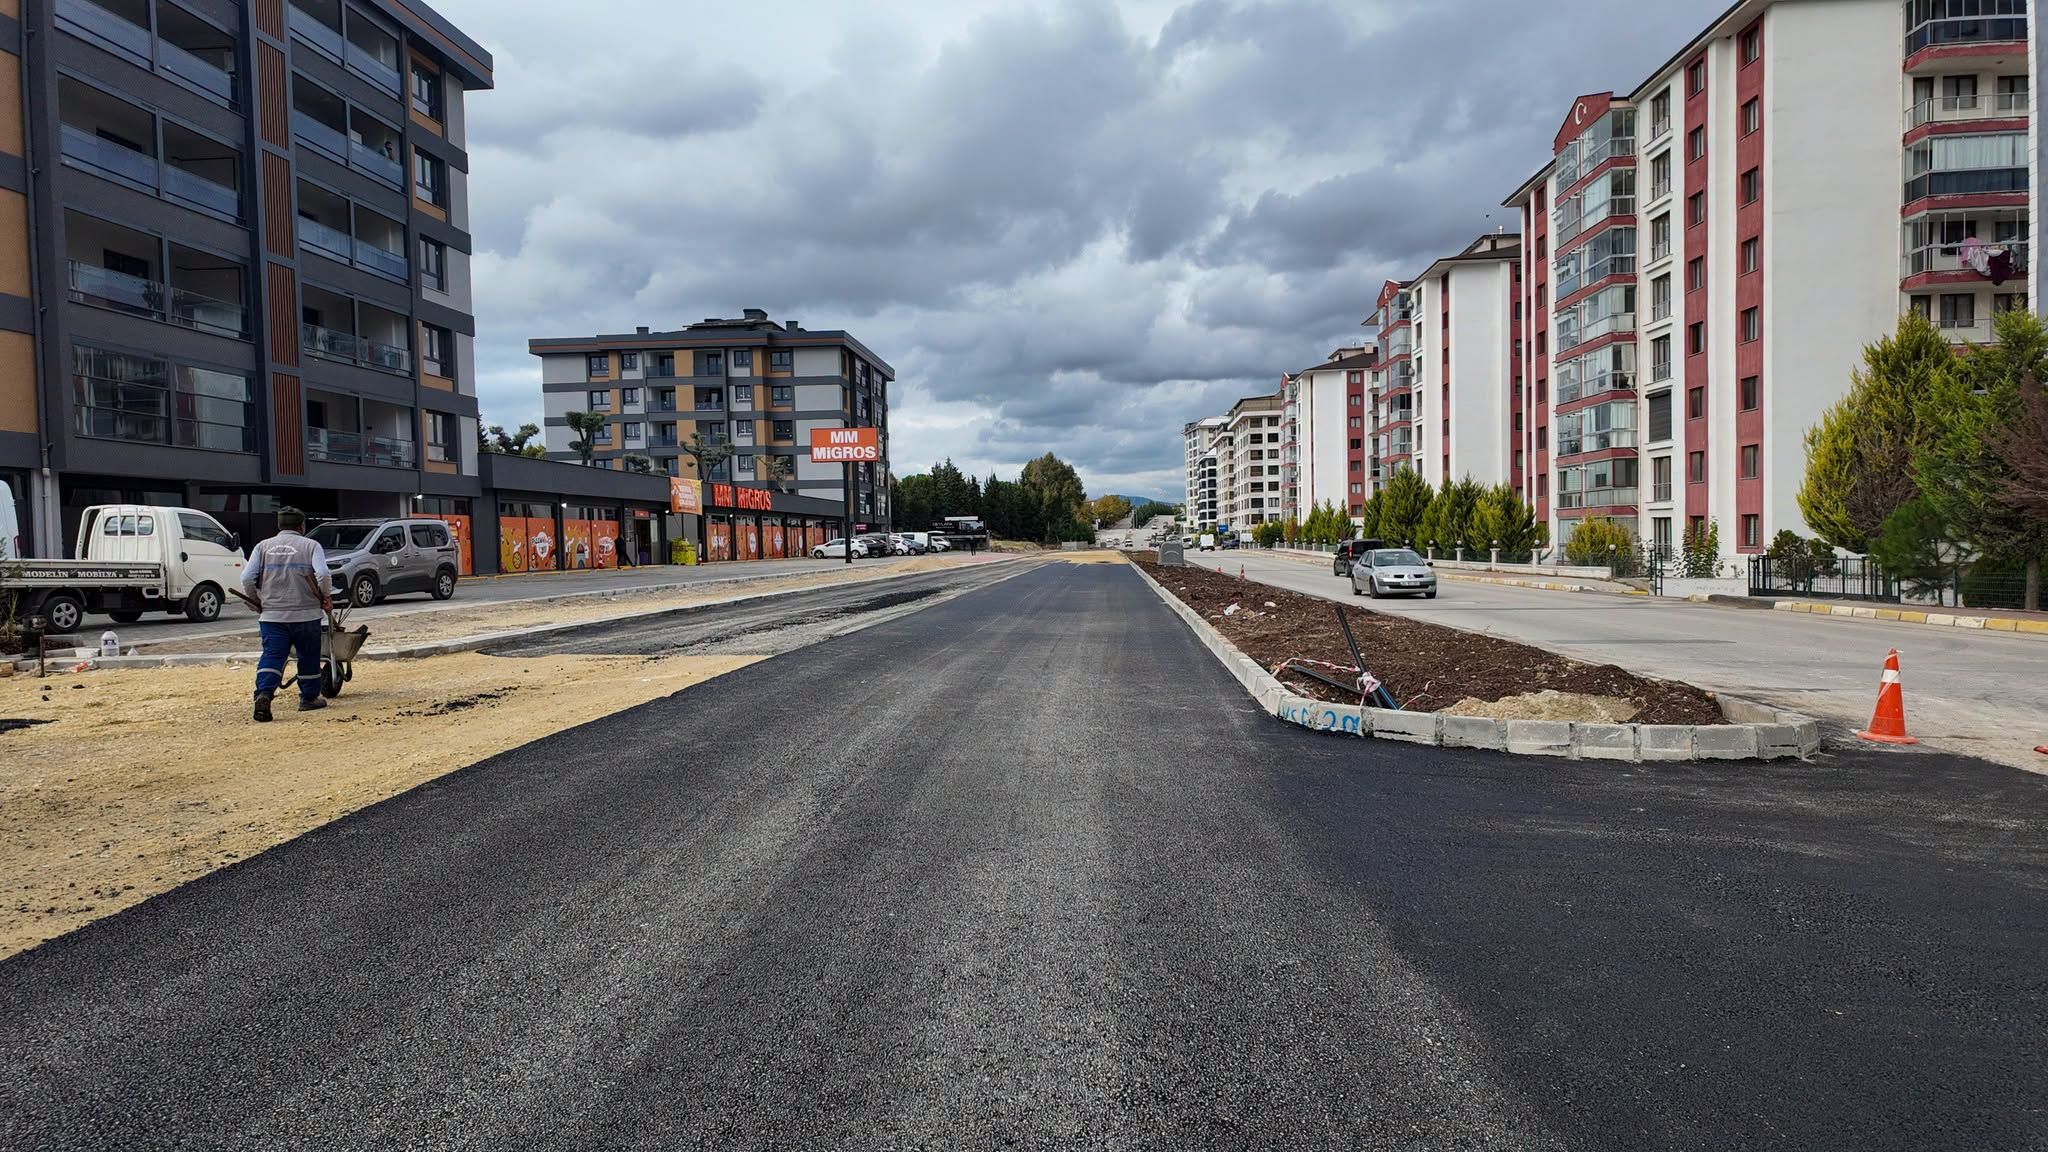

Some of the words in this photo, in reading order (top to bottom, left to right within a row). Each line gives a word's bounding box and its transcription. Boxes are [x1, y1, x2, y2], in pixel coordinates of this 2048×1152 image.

[830, 431, 858, 444] MM
[813, 446, 876, 460] MiGROS
[713, 484, 733, 508] MM
[737, 486, 772, 511] MiGROS
[77, 569, 117, 578] MOBİLYA
